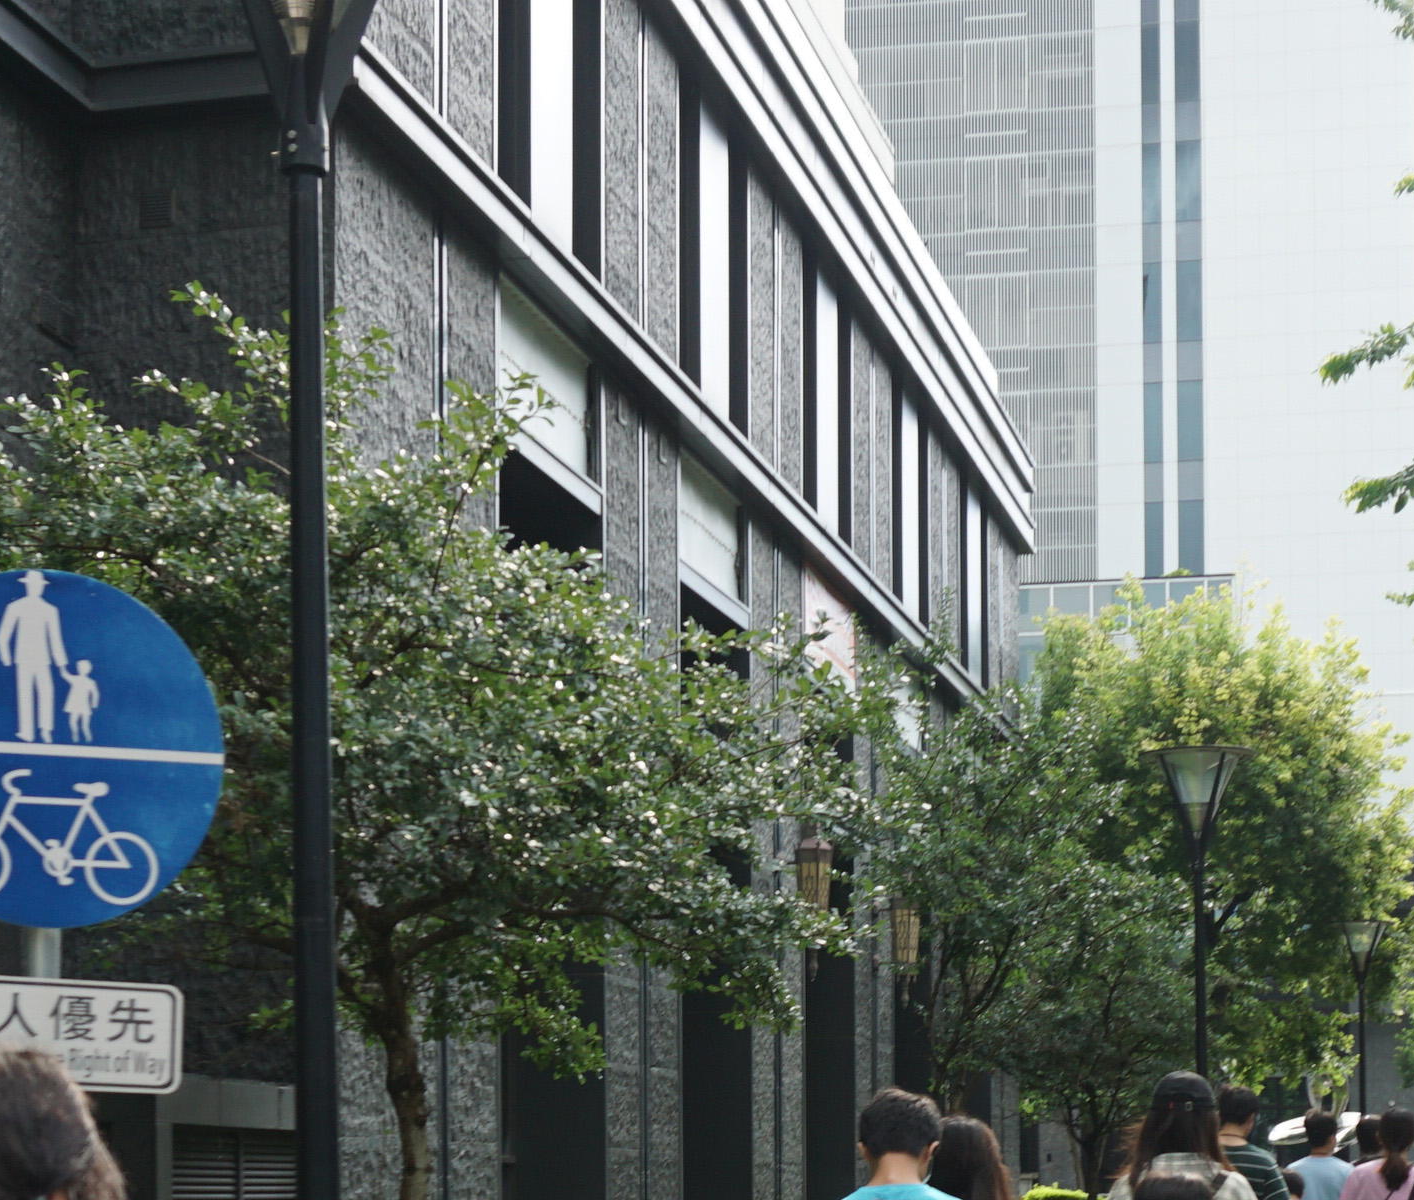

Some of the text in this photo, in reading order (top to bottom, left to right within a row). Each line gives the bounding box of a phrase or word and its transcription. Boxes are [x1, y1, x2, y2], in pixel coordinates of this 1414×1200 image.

[68, 1048, 165, 1081] Right of Way
